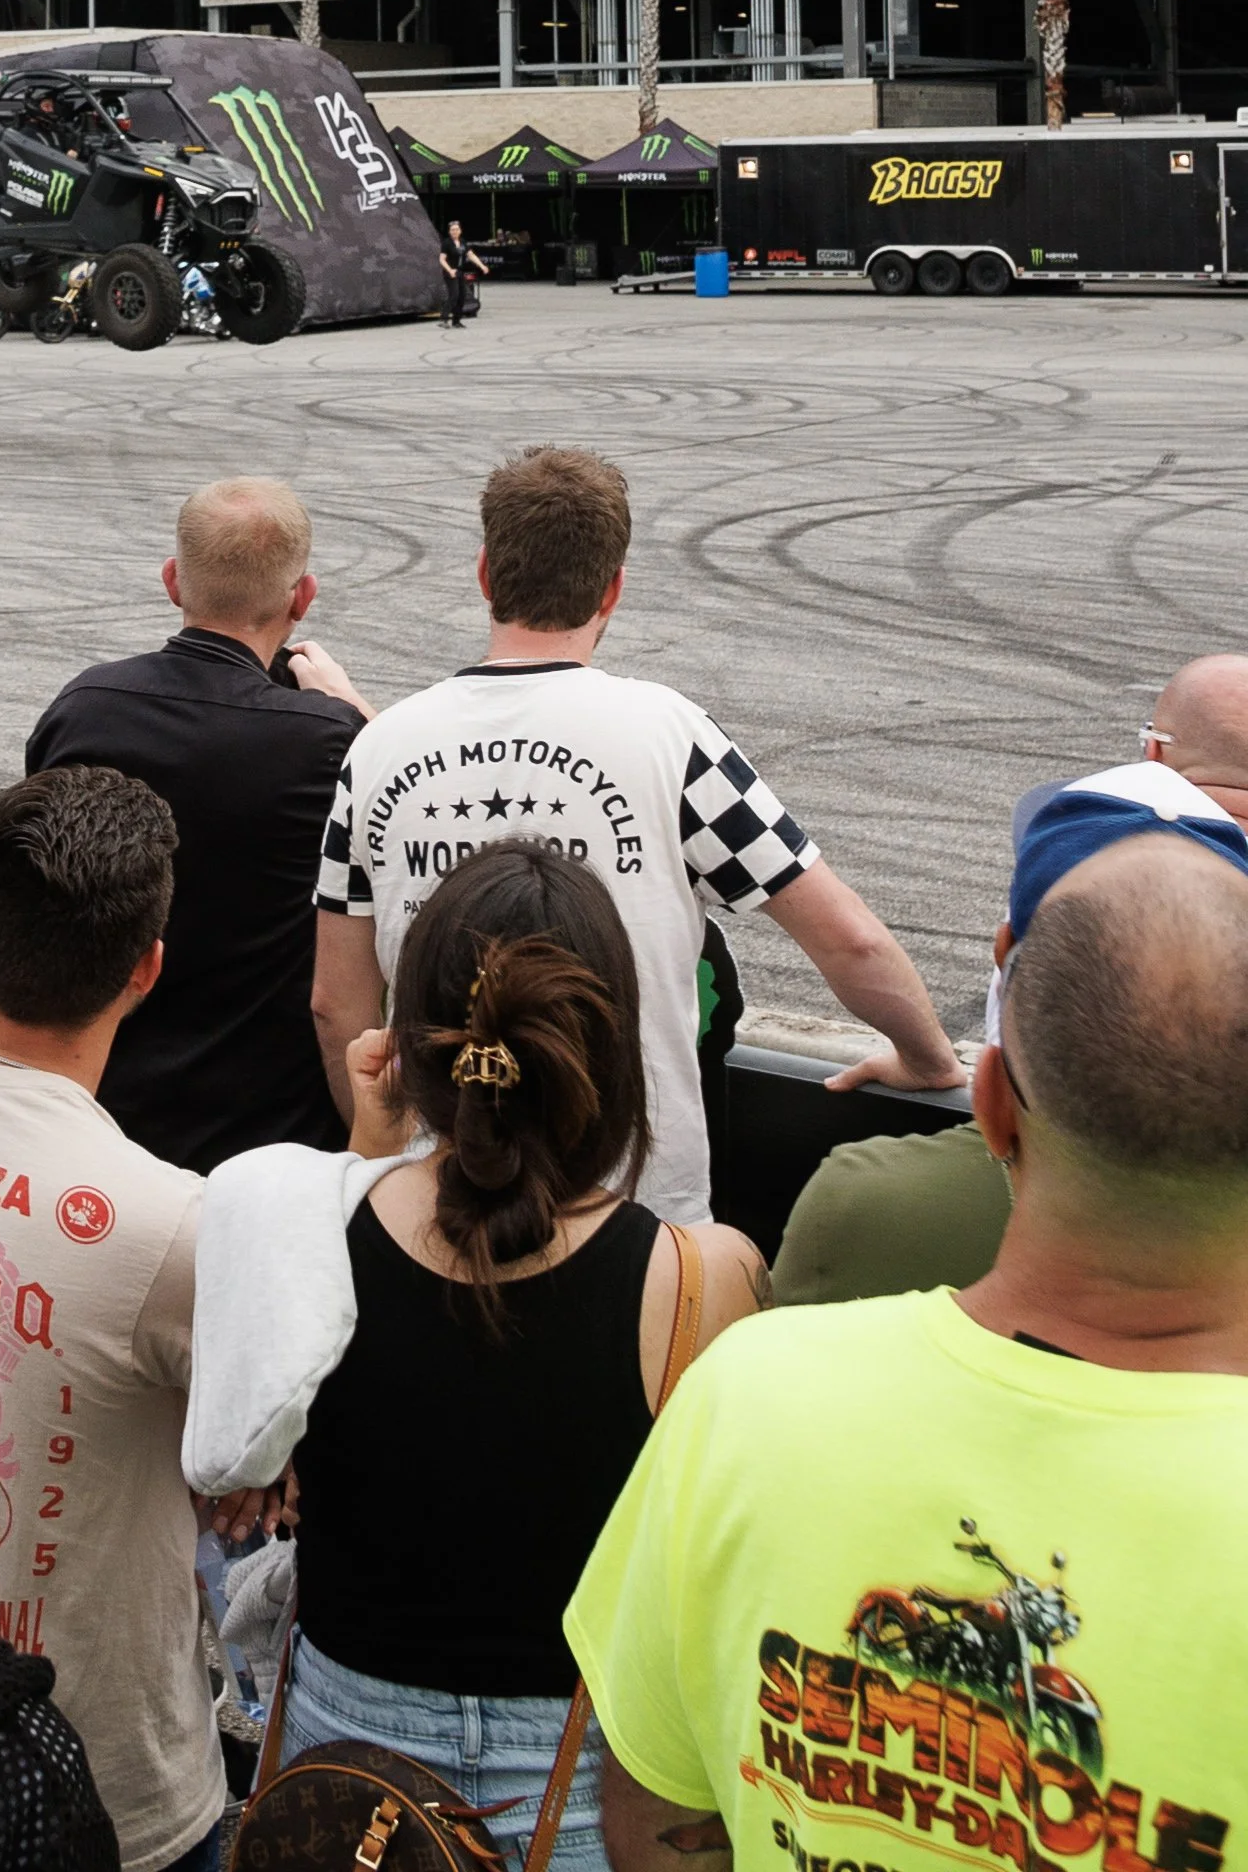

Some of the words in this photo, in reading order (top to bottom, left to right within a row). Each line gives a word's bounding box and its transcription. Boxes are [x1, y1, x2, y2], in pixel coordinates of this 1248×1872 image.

[473, 173, 524, 183] MONSTER
[618, 171, 667, 182] MONSTER
[869, 157, 1002, 205] BAGGSY
[367, 750, 447, 872] TRIUMPH
[460, 739, 643, 874] MOTORCYCLES
[758, 1628, 1230, 1872] SEMINOLE
